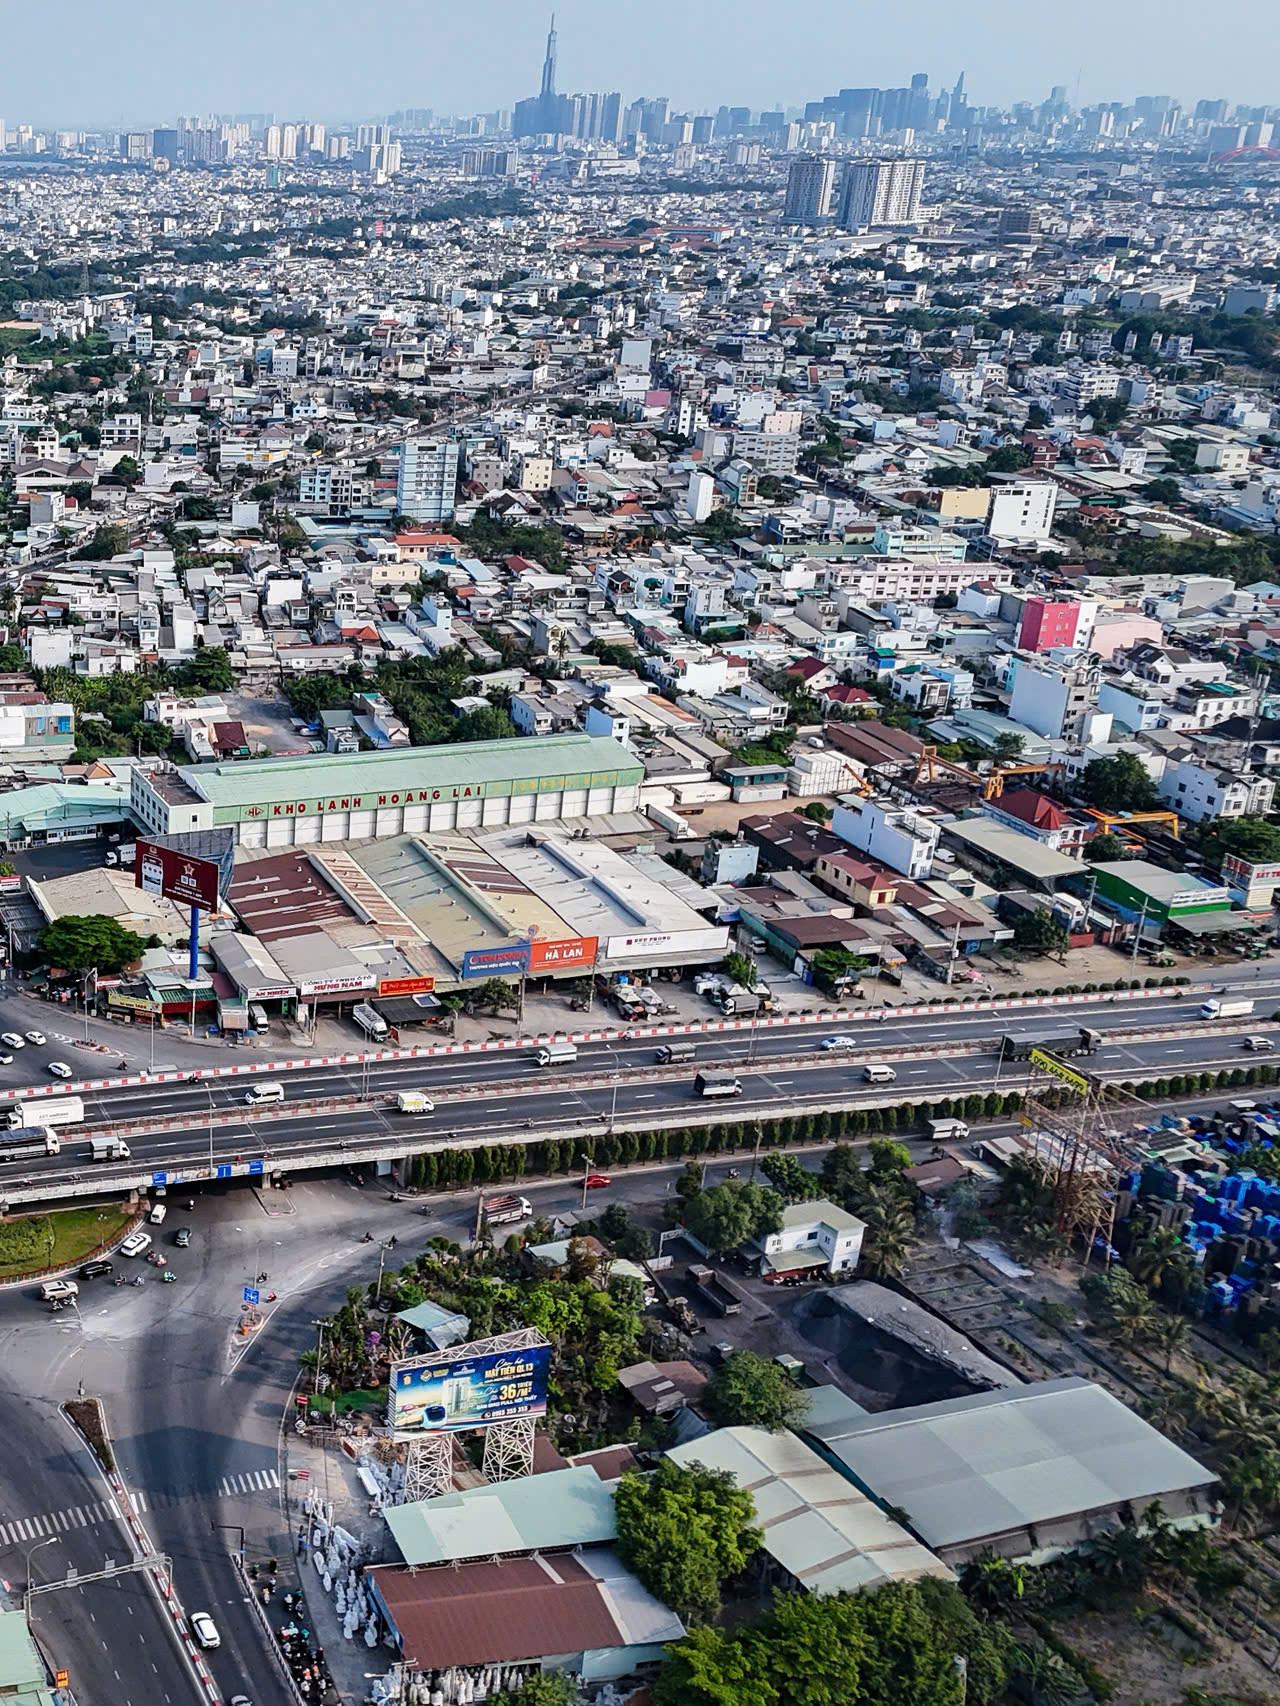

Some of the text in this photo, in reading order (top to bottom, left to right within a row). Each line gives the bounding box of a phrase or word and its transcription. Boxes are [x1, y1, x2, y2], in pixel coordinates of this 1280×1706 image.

[273, 803, 306, 815] KHO
[317, 798, 361, 812] LẠNH
[452, 786, 481, 797] LAI
[545, 948, 583, 960] HÀ LAN
[499, 1383, 516, 1400] 36
